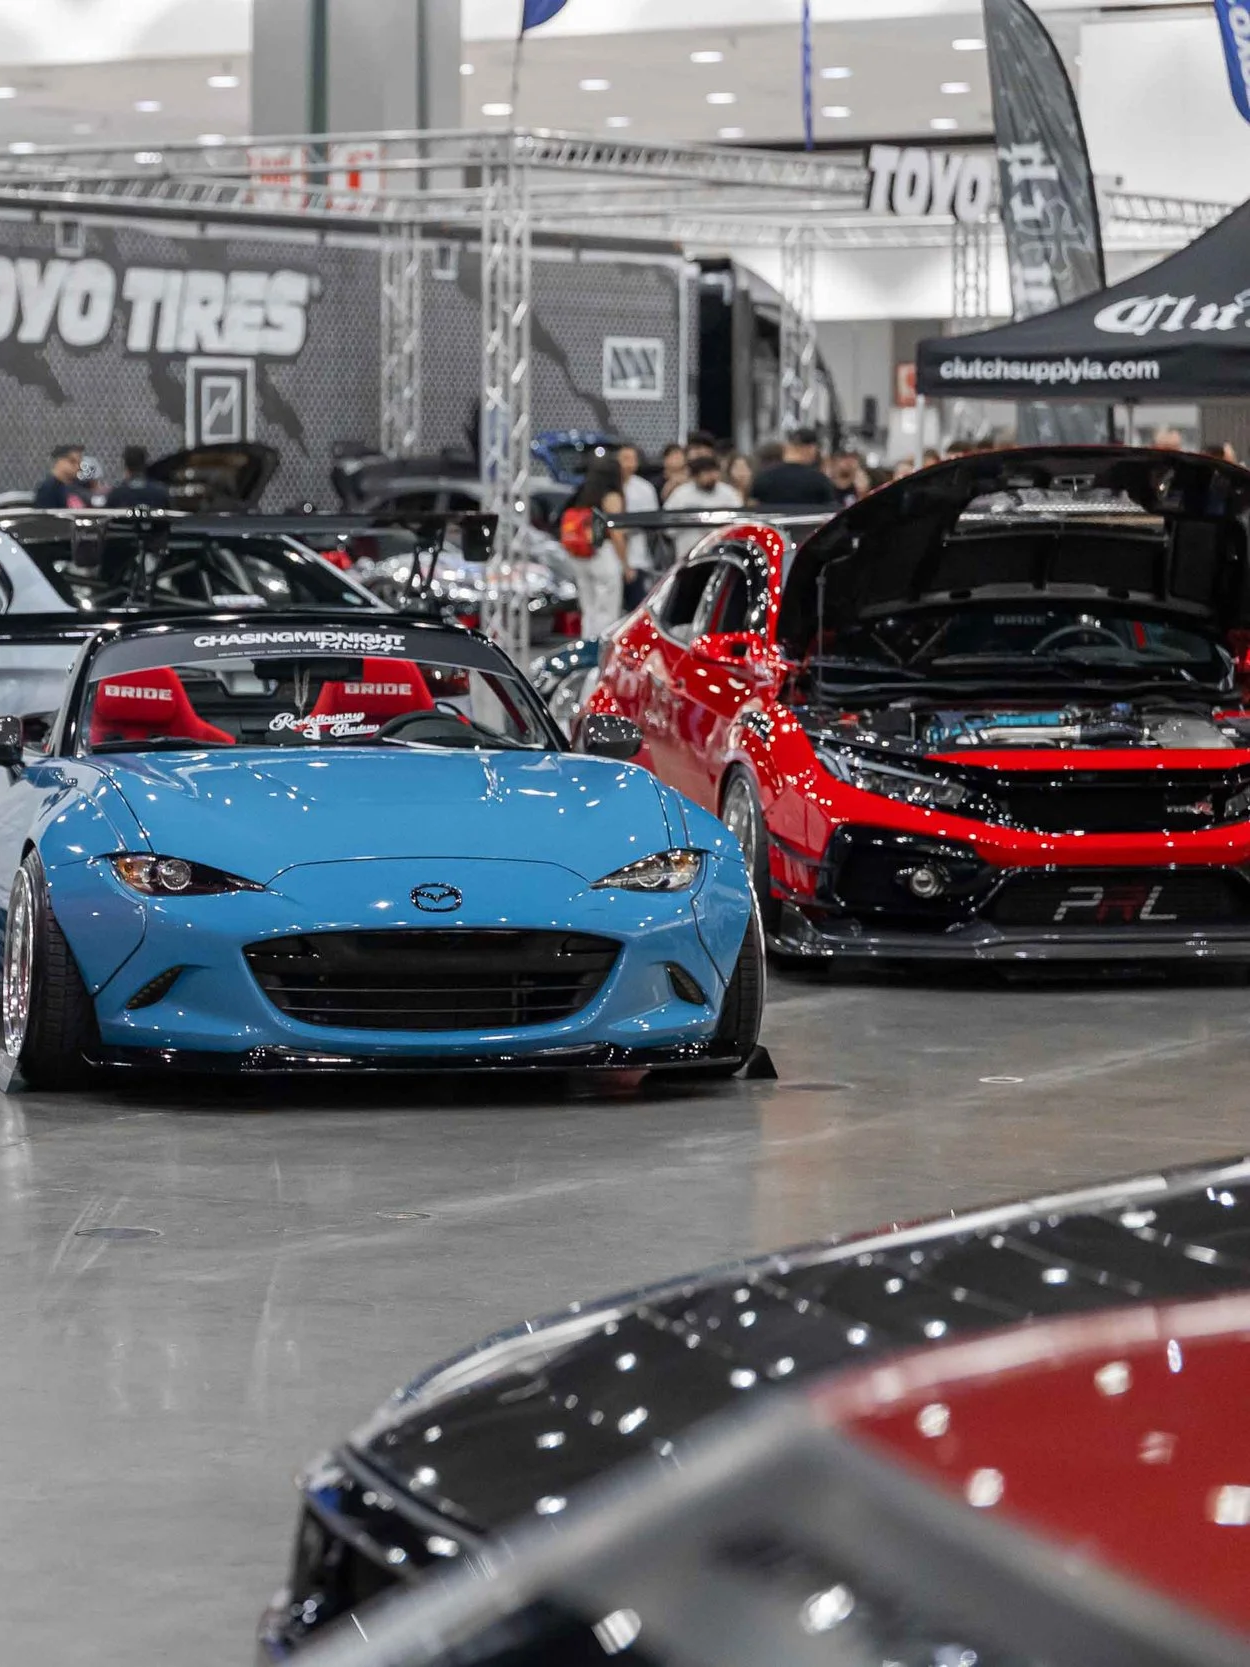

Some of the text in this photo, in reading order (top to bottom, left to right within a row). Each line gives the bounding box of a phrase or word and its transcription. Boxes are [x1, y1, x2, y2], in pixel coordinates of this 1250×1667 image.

[869, 144, 991, 223] TOYO
[122, 267, 310, 356] TIRES
[1094, 287, 1250, 337] Clu
[939, 356, 1160, 384] clutchsupplyla.com
[194, 631, 406, 648] CHASINGMIDNIGHT
[104, 684, 173, 701] BRIDE
[344, 682, 413, 696] BRIDE
